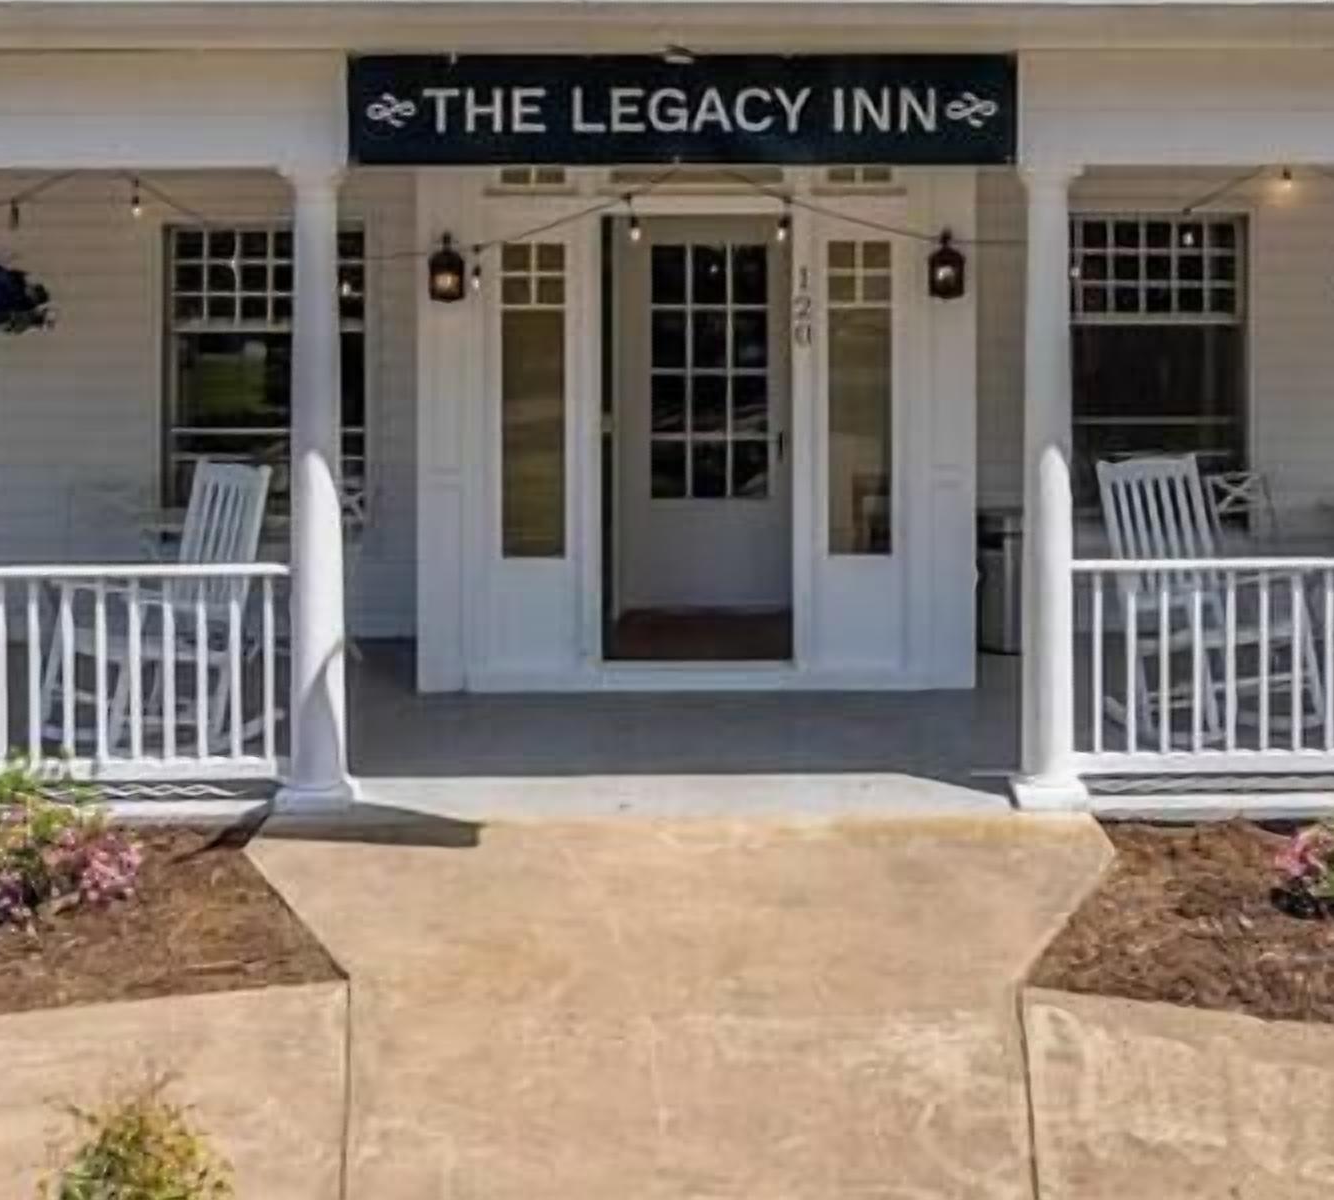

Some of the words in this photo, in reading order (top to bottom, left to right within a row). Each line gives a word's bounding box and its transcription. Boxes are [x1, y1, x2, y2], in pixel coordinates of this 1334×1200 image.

[422, 87, 547, 134] THE
[572, 87, 811, 134] LEGACY
[833, 87, 938, 134] INN
[794, 266, 811, 347] 120
